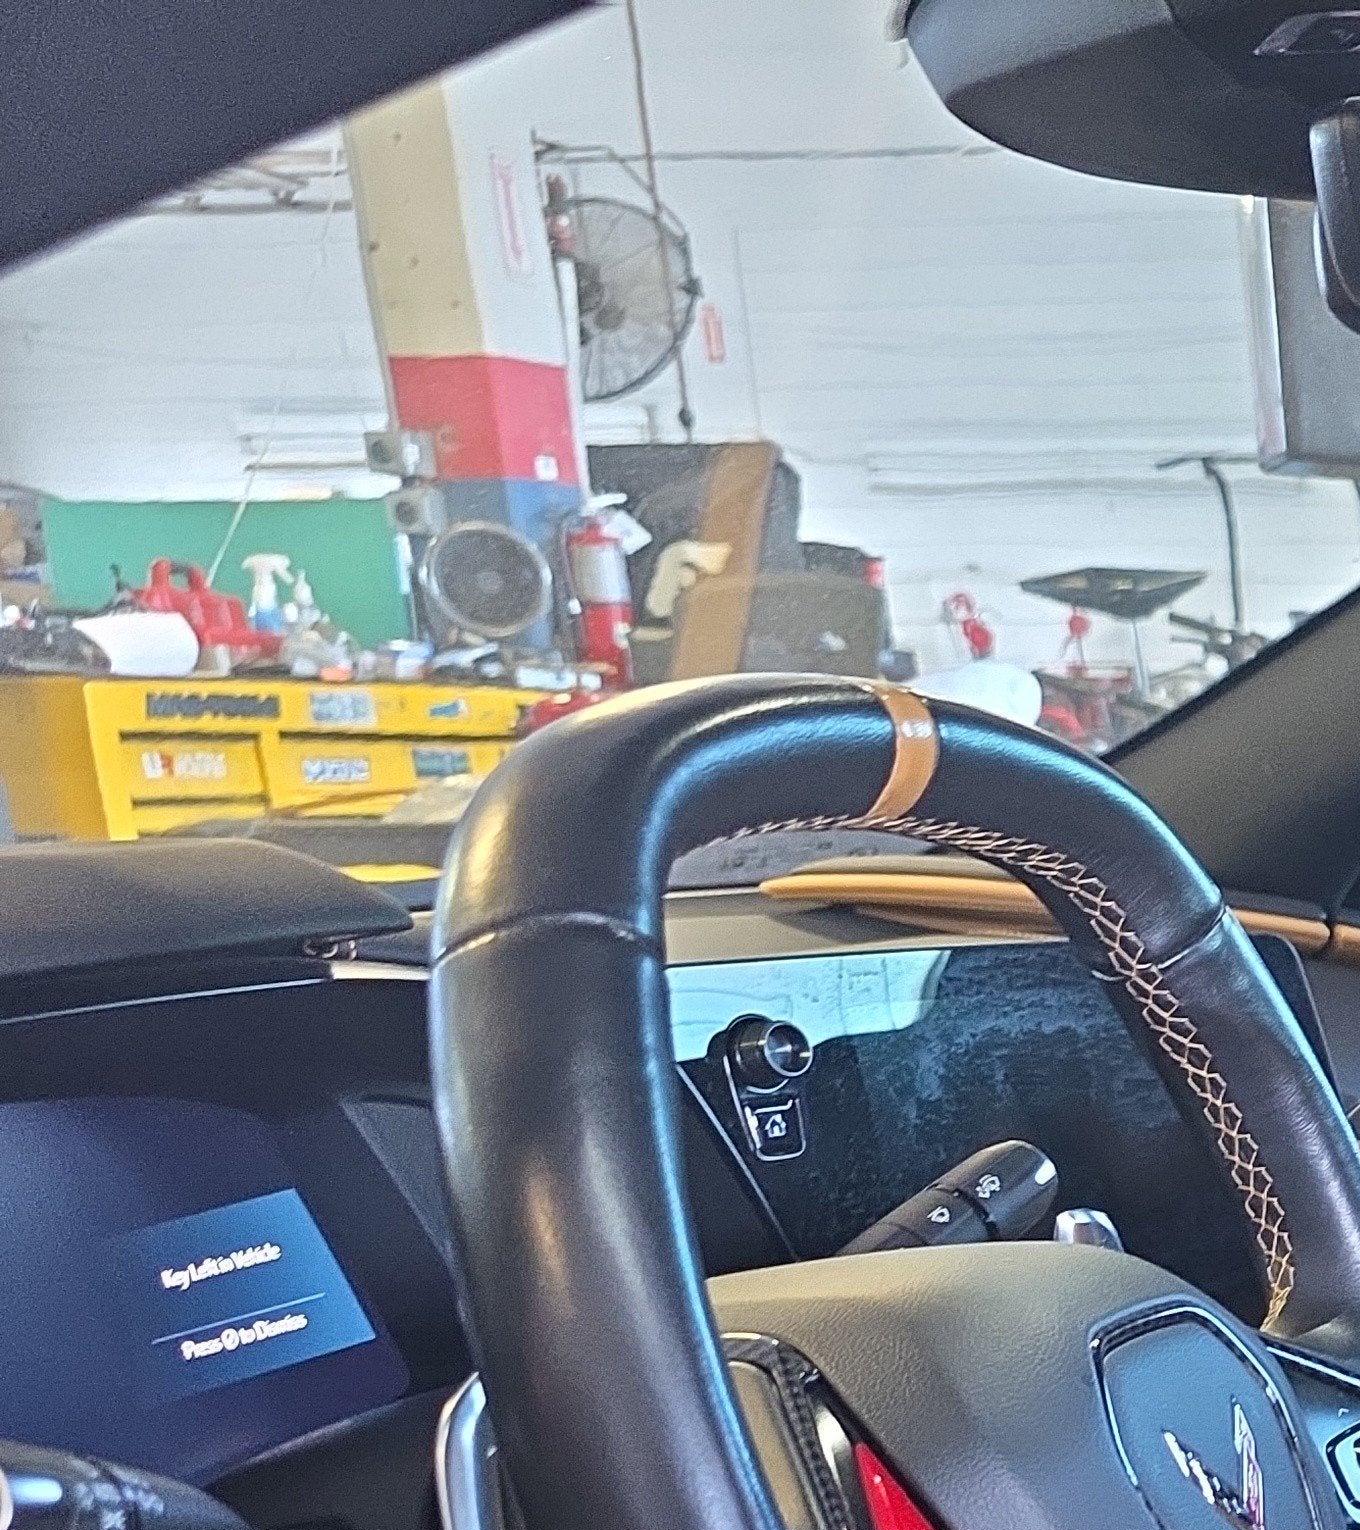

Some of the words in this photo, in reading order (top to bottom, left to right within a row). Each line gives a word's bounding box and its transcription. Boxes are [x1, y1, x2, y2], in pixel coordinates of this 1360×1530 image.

[161, 1269, 191, 1290] Key
[188, 1257, 220, 1281] Left
[230, 1242, 282, 1270] Vehicle
[181, 1338, 223, 1360] Press
[238, 1327, 257, 1345] to
